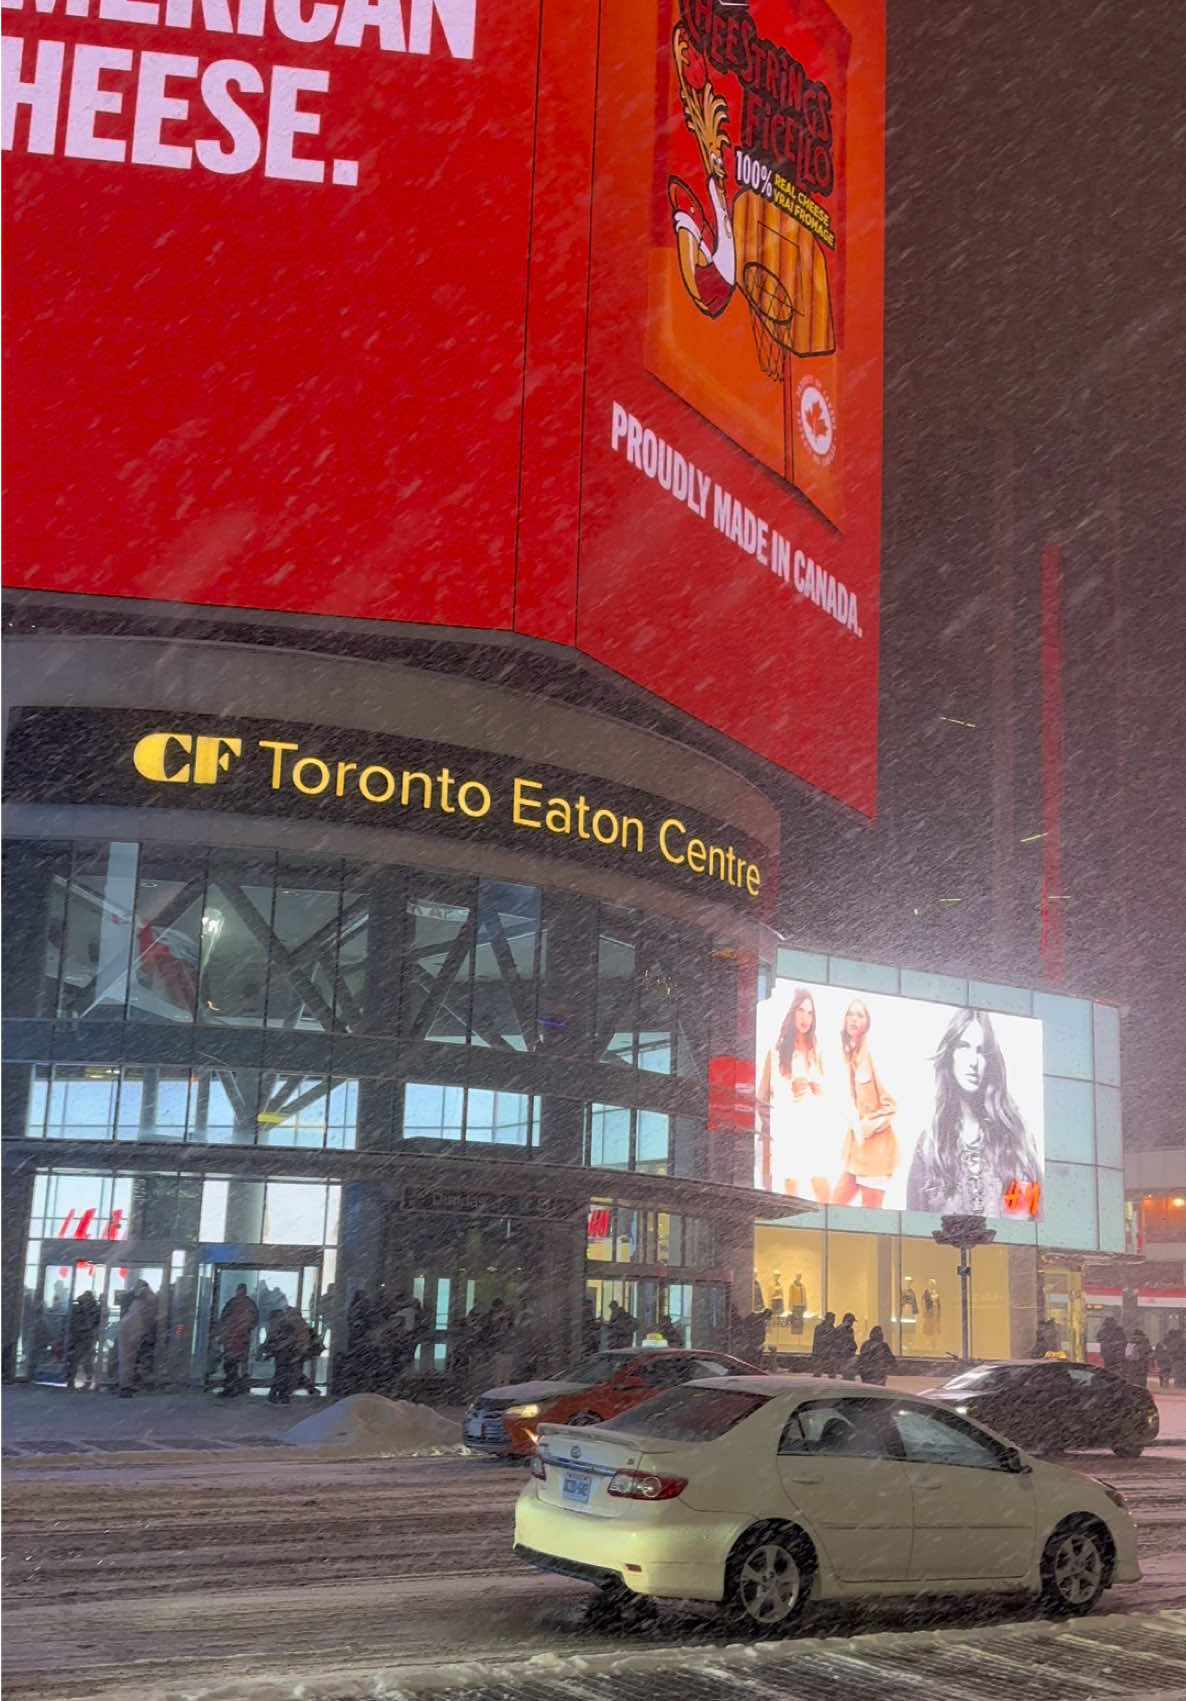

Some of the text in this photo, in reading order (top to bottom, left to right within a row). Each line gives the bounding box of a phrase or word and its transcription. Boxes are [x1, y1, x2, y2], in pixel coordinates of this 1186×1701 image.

[1, 36, 359, 186] HEESE.
[736, 151, 773, 198] 100%
[774, 173, 830, 226] REAL CHEESE
[794, 204, 835, 248] FROMAGE
[611, 400, 711, 519] PROUDLY
[713, 484, 768, 566] MADE
[770, 530, 791, 583] IN
[794, 550, 863, 638] CANADA.
[133, 732, 762, 897] CF Toronto Eaton Centre
